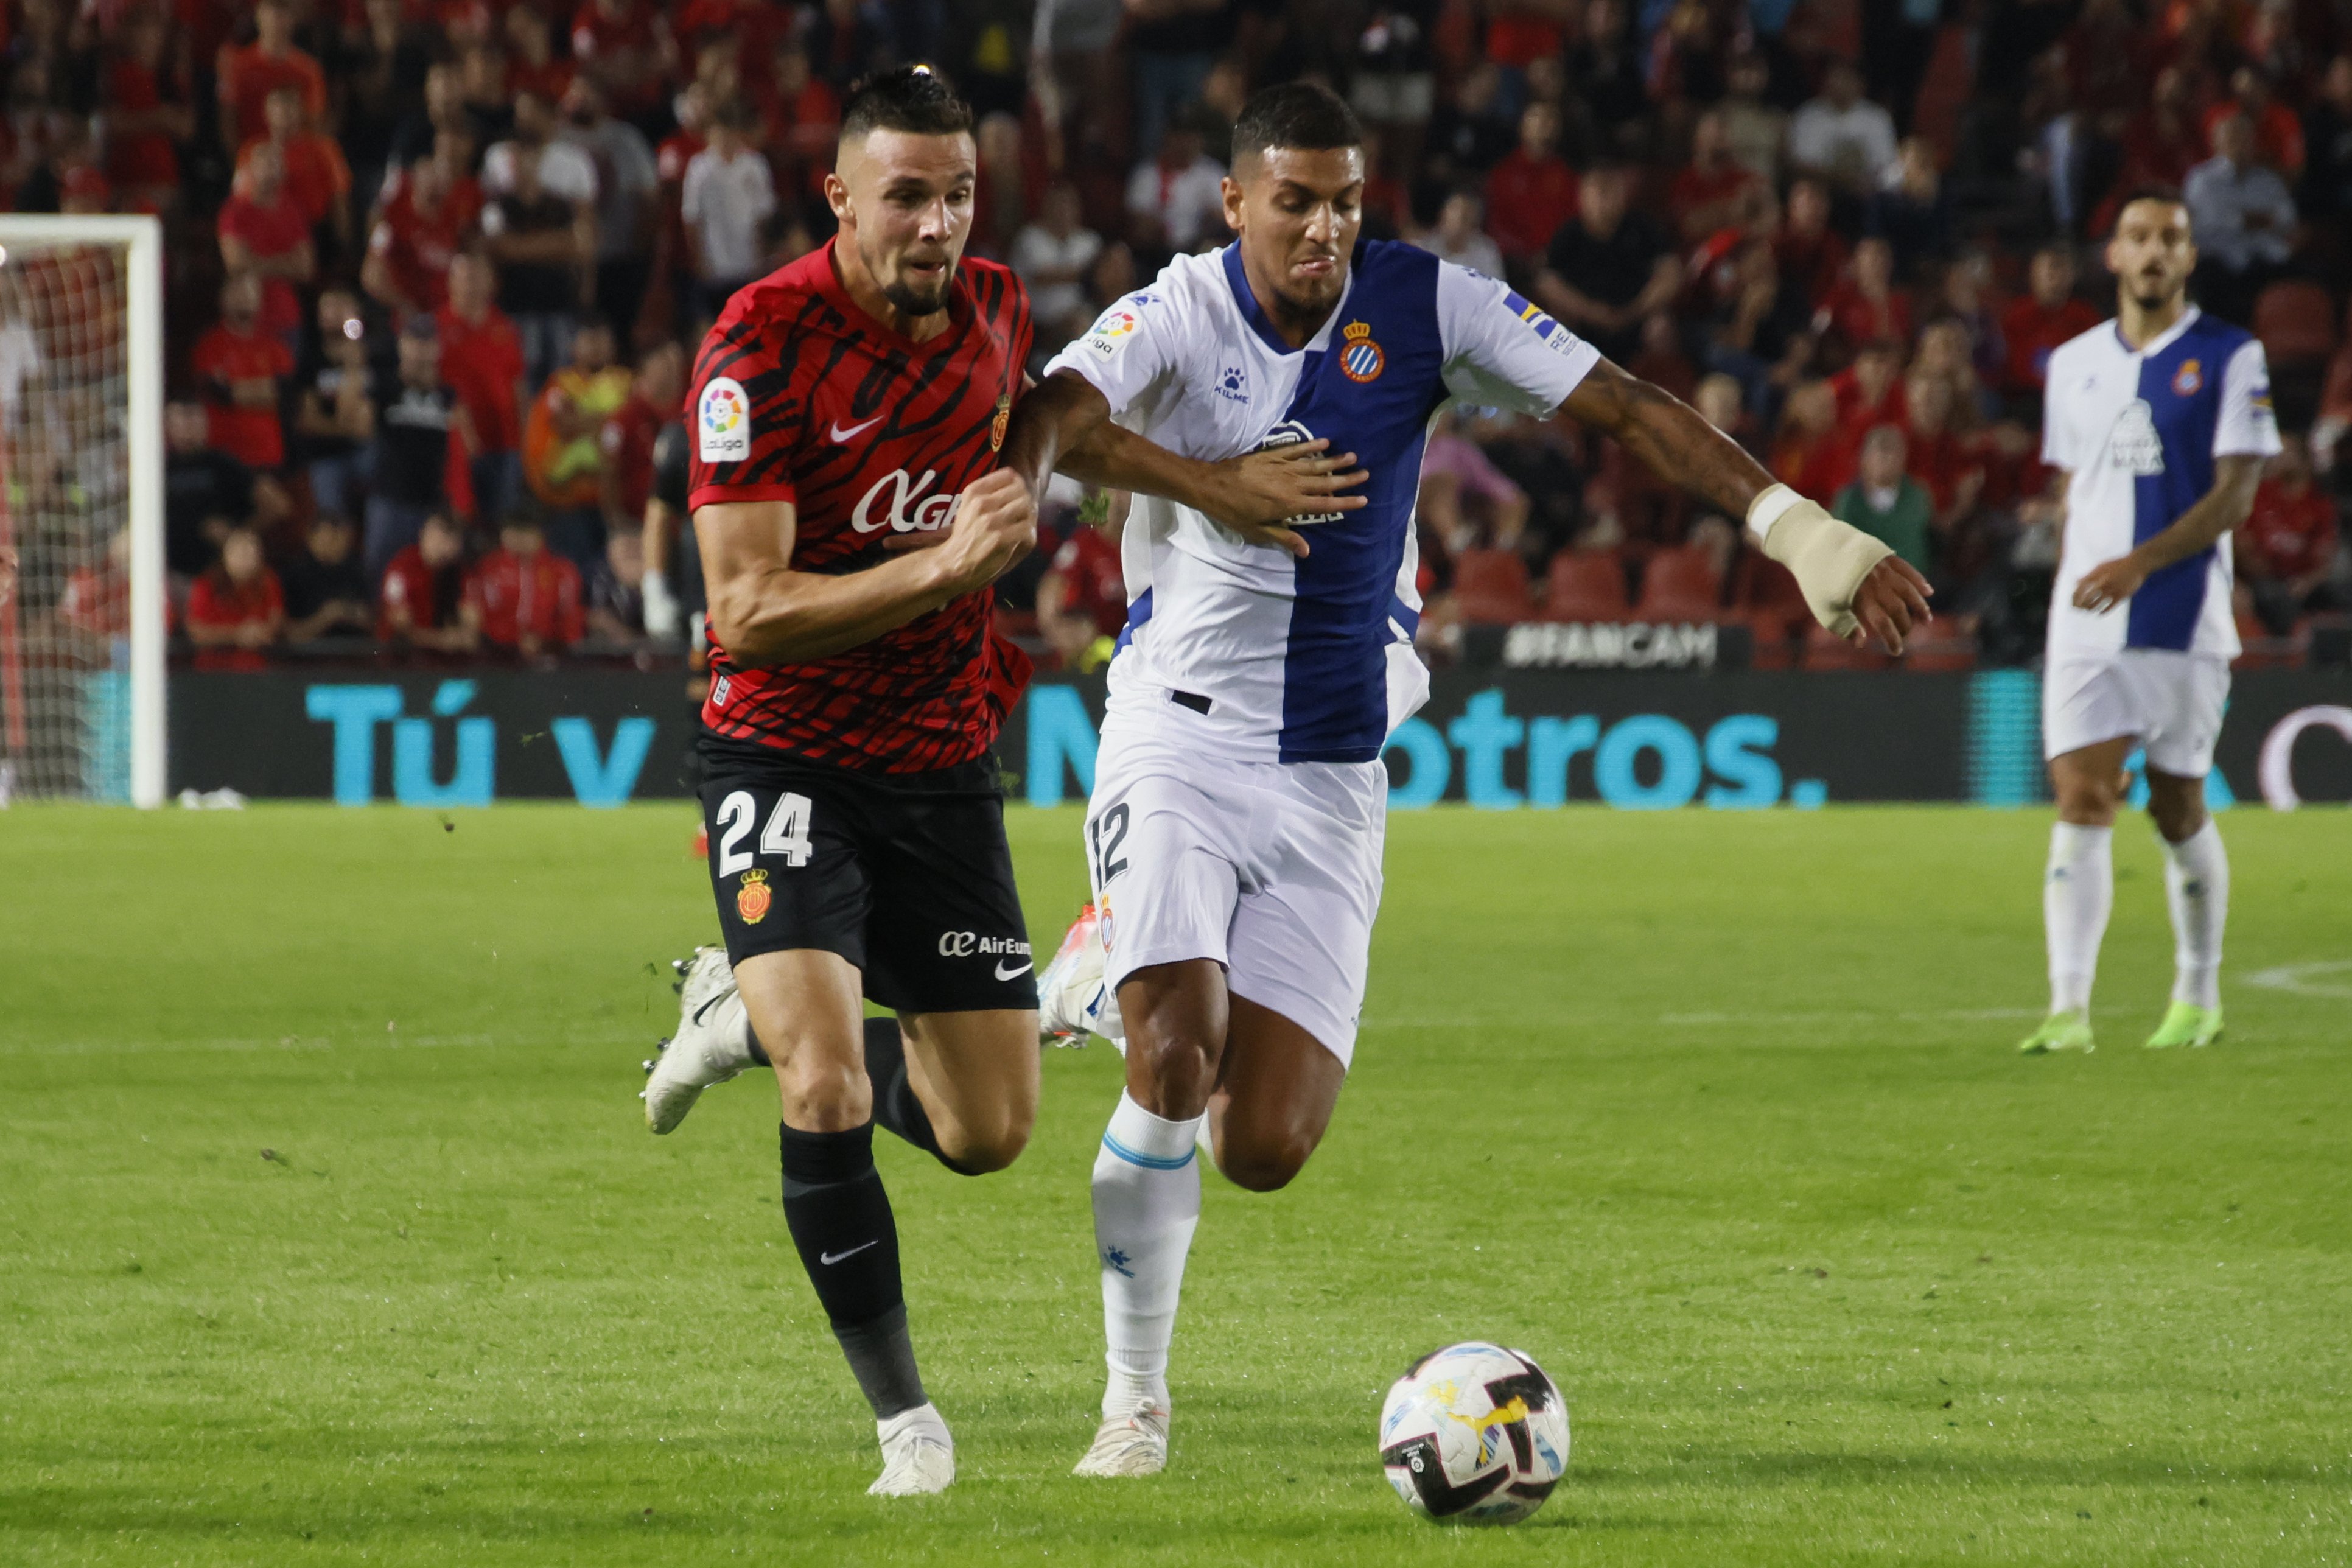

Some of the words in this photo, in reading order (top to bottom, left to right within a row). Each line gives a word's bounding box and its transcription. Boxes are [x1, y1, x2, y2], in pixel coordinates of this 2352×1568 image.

[1550, 331, 1569, 351] RE
[1504, 621, 1718, 668] #FANCAM
[306, 679, 497, 808] Tú
[716, 791, 813, 878] 24
[1092, 802, 1130, 894] 12
